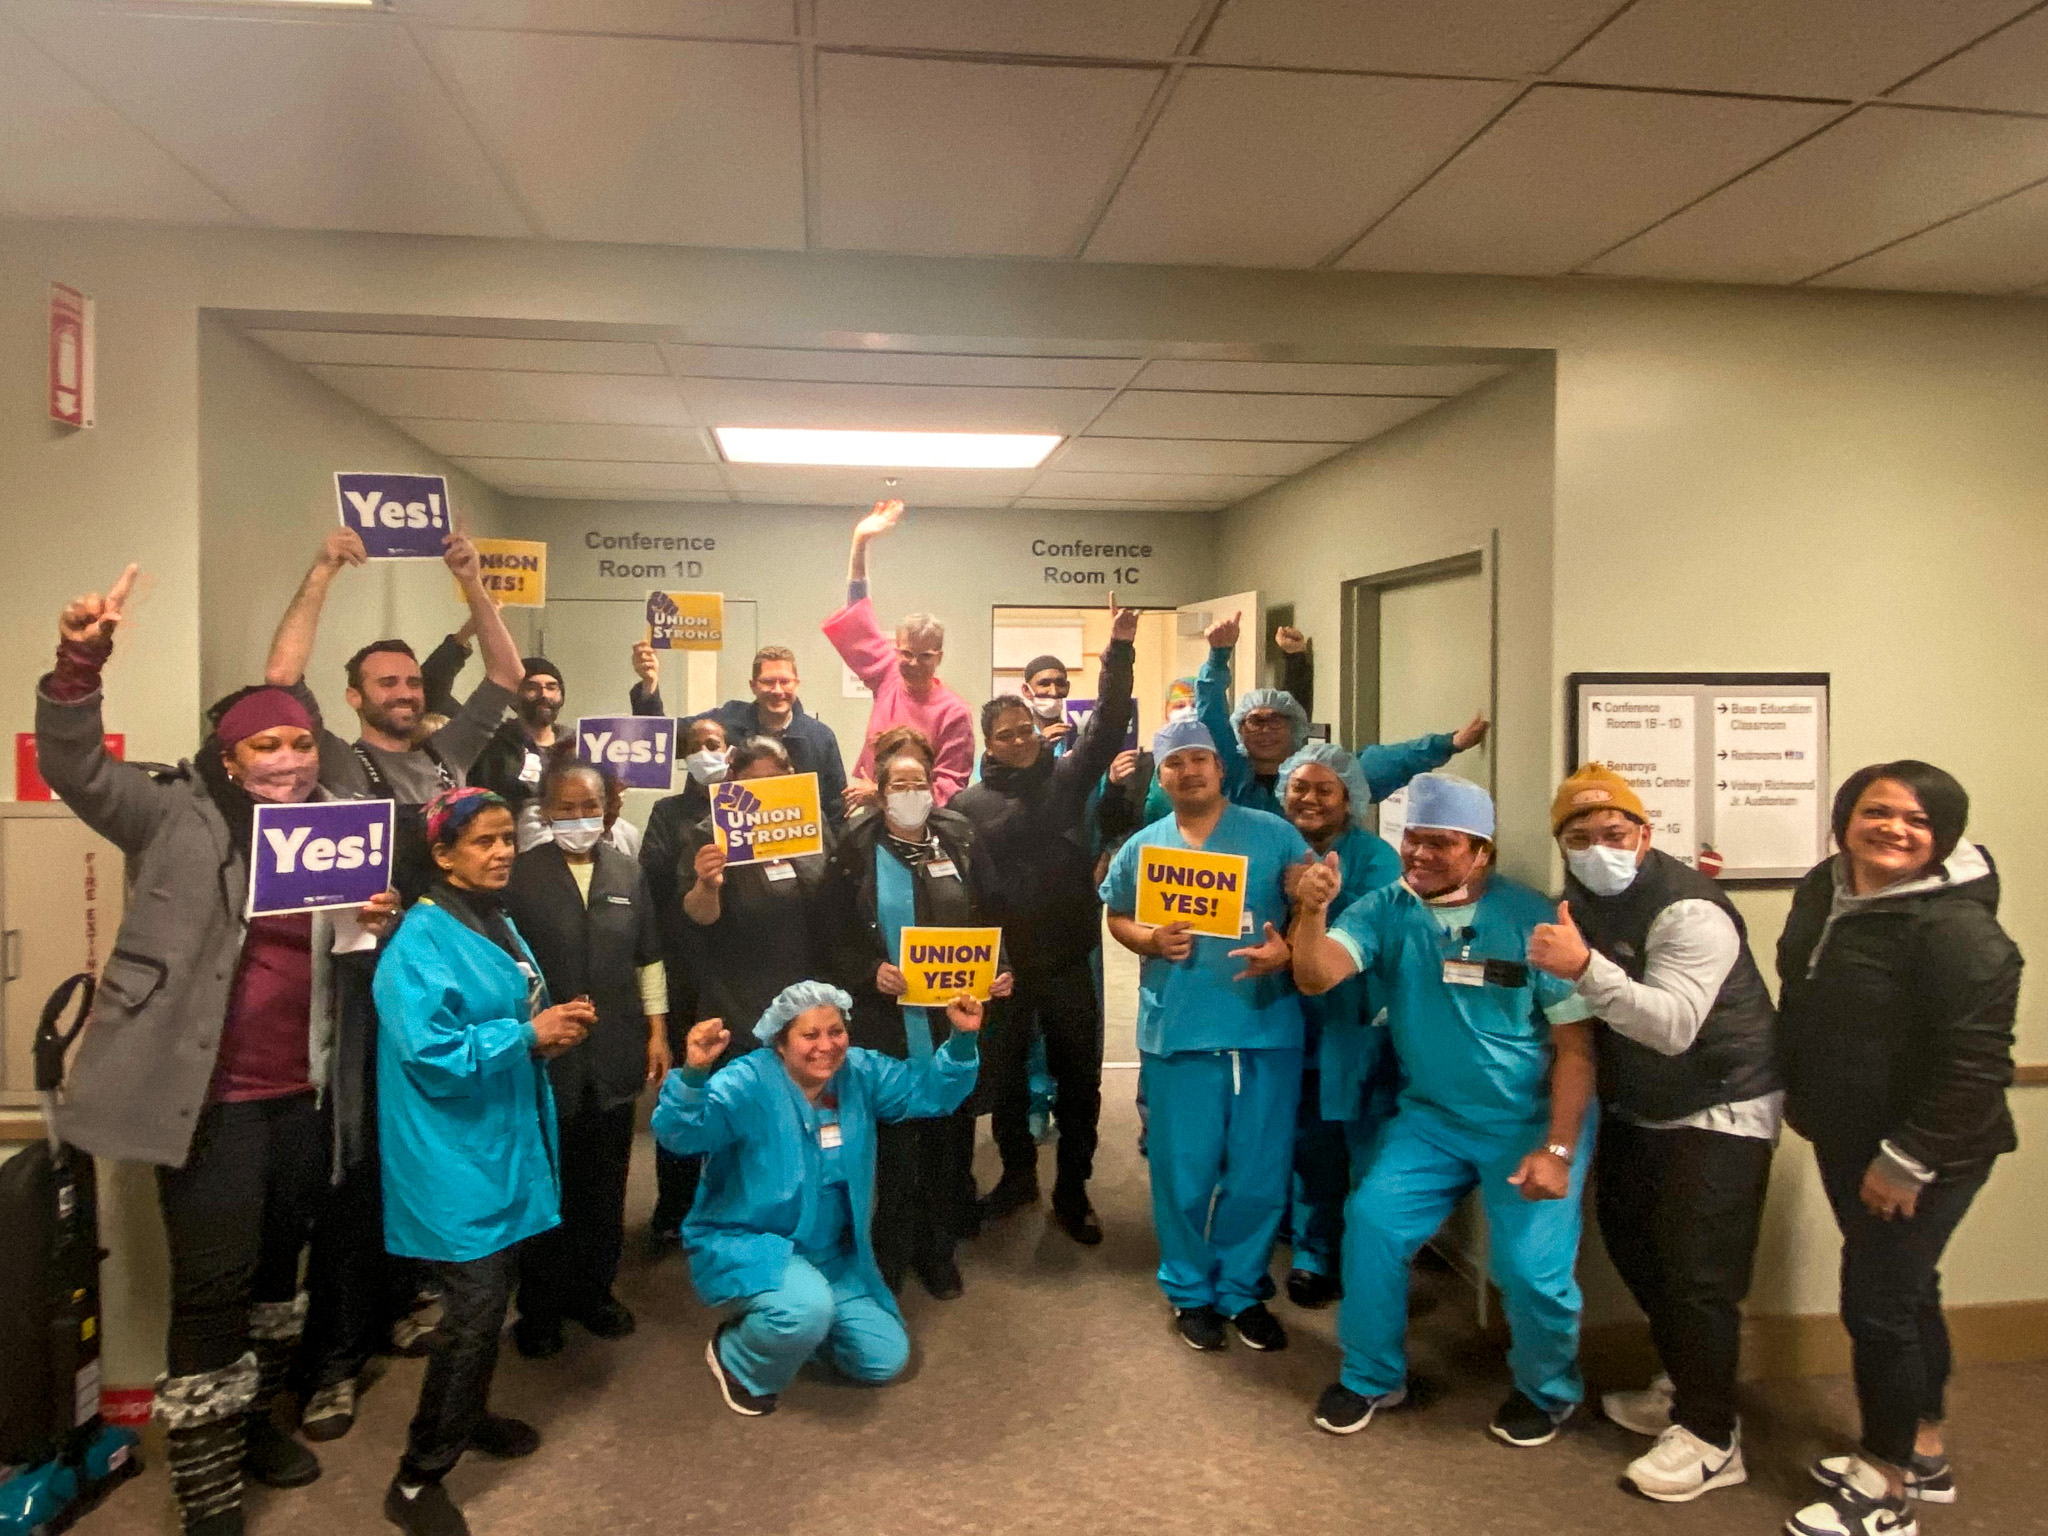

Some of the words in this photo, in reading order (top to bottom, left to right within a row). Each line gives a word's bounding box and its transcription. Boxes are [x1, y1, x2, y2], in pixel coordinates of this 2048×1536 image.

[344, 491, 443, 529] Yes!
[585, 531, 716, 551] Conference
[1031, 539, 1153, 558] Conference
[479, 554, 538, 572] NION
[599, 560, 666, 578] Room
[674, 560, 702, 578] 1D
[1044, 566, 1105, 584] Room
[1113, 566, 1140, 584] 1C
[654, 612, 708, 626] UNION
[653, 626, 720, 639] STRONG
[1605, 702, 1661, 713] Conference
[1606, 718, 1642, 729] Rooms
[583, 731, 667, 765] Yes!
[1655, 776, 1691, 788] Center
[727, 806, 802, 829] UNION
[729, 825, 818, 849] STRONG
[262, 822, 384, 874] Yes!
[1146, 862, 1238, 893] UNION
[1160, 892, 1220, 918] YES!
[909, 944, 992, 964] UNION
[923, 970, 975, 990] YES!
